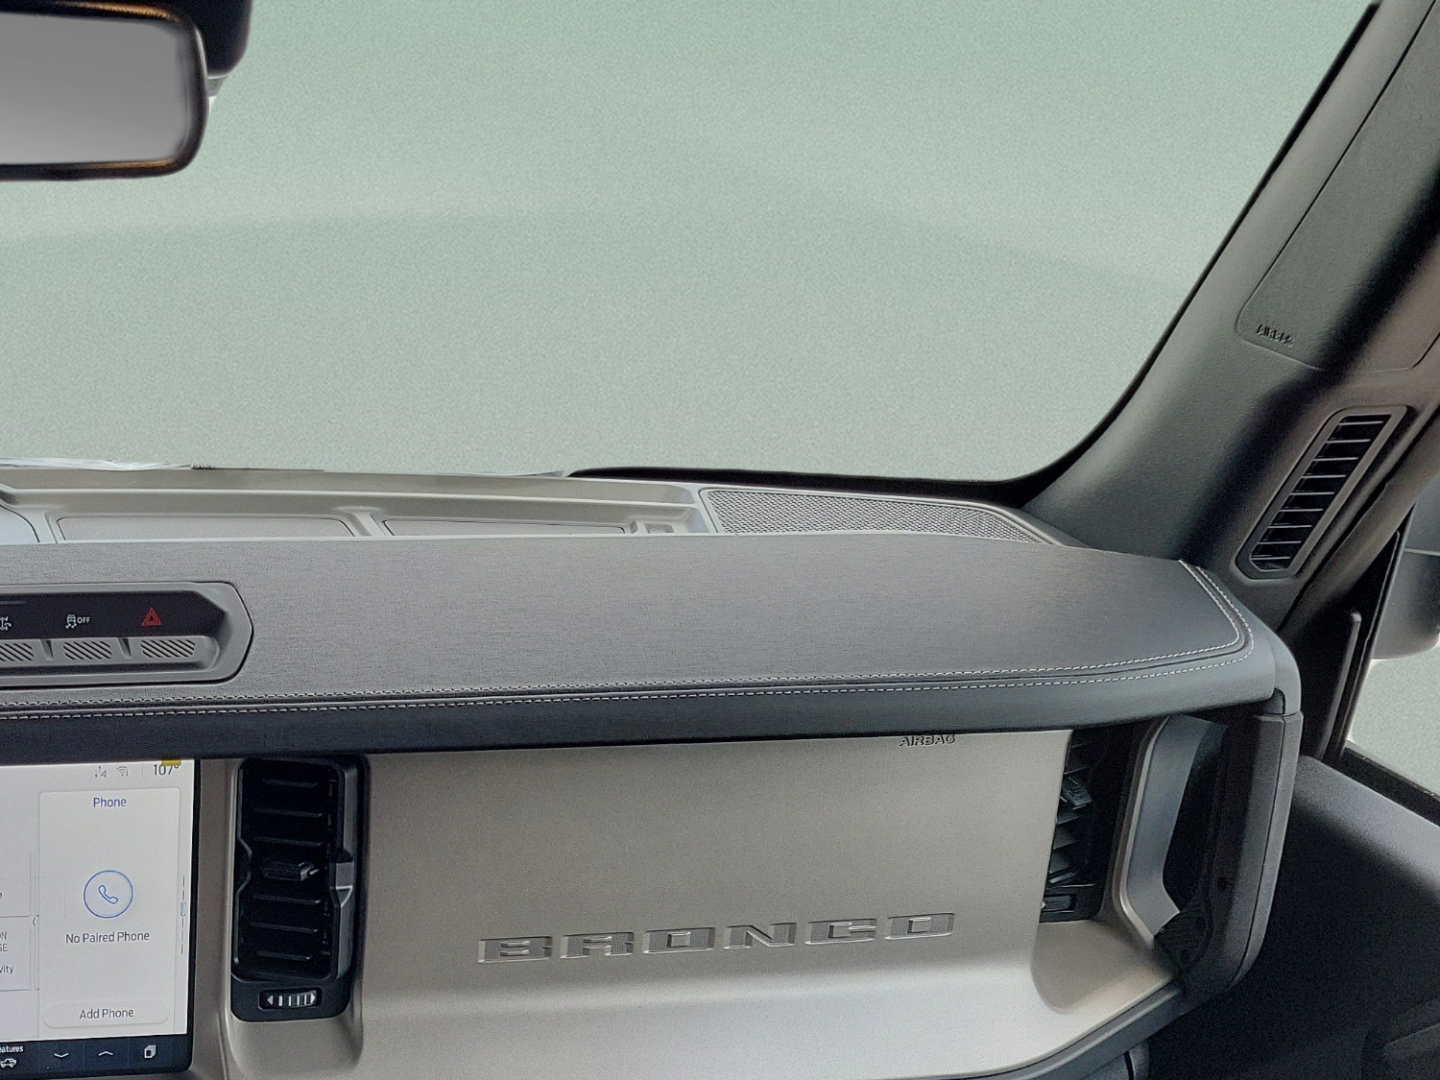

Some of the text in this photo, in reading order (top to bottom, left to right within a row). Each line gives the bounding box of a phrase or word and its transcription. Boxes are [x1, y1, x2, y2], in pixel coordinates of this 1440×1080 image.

[76, 616, 90, 624] OFF
[899, 734, 956, 746] AIRBAG
[93, 798, 127, 808] Phone
[66, 932, 150, 944] No Paired Phone
[477, 912, 956, 964] BRONCO
[80, 1008, 134, 1019] Add Phone
